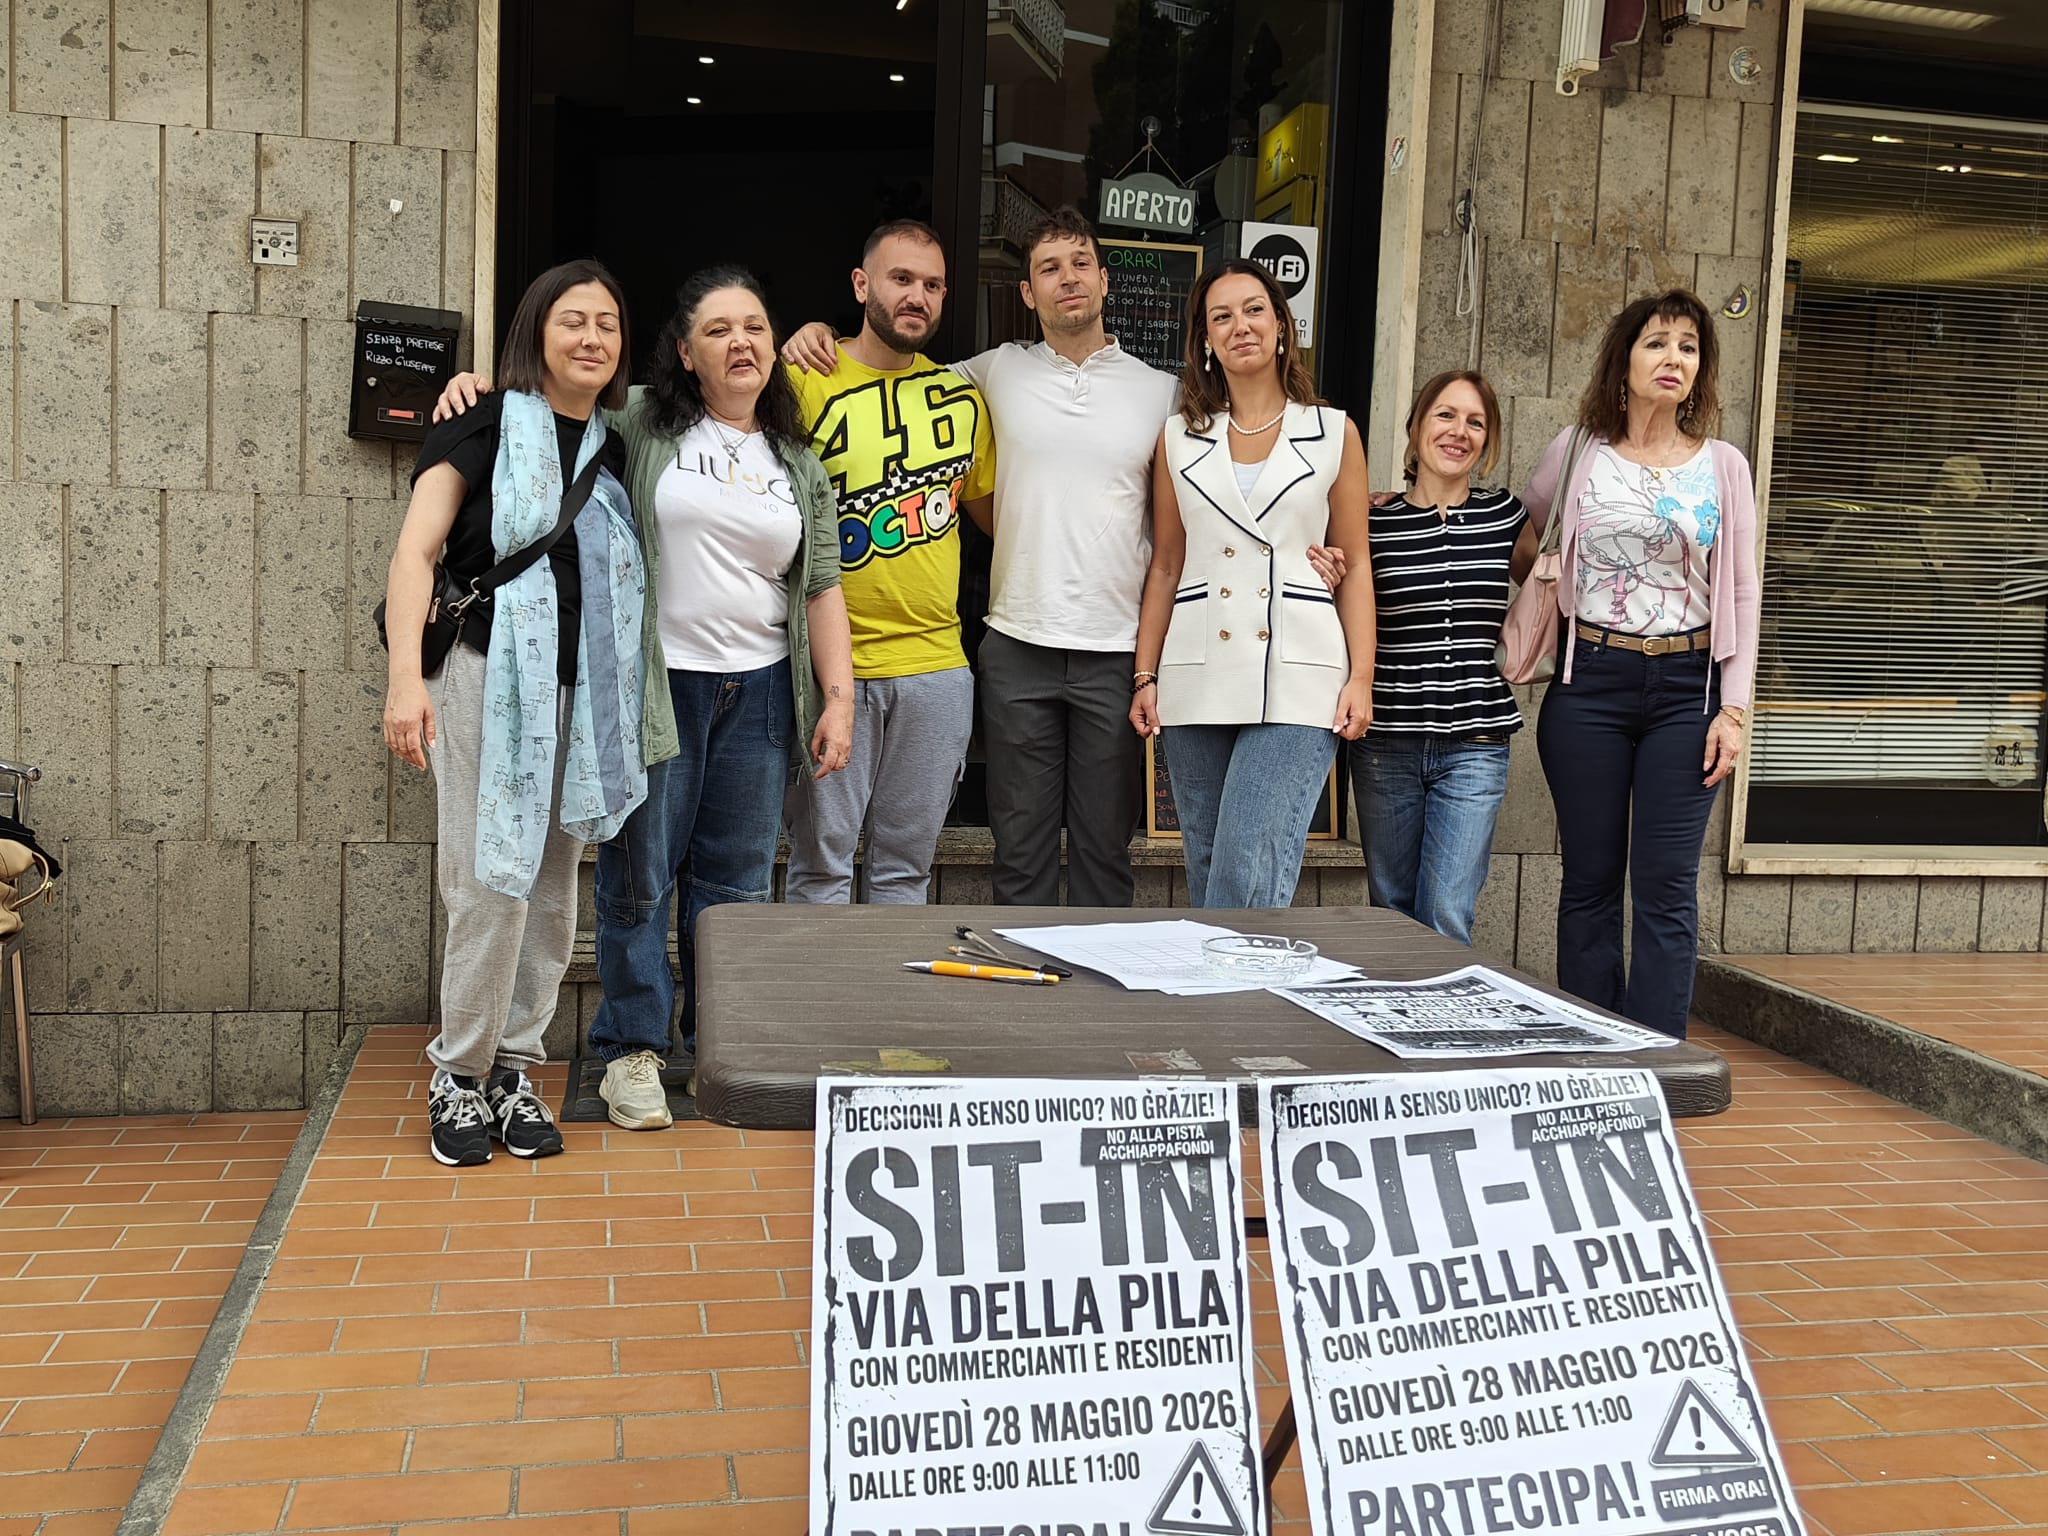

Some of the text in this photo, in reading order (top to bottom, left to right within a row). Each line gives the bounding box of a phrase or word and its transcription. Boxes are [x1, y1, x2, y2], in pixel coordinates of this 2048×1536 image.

[1105, 188, 1193, 227] APERTO
[1107, 250, 1163, 272] ORARI
[1160, 276, 1171, 286] AL
[1107, 293, 1134, 306] 8:00
[366, 333, 445, 352] SENZA PRETESE
[1105, 316, 1131, 326] NERDI
[1147, 320, 1180, 330] SABATO
[365, 350, 437, 374] RIZZO GIUSEPPE
[1120, 344, 1158, 354] OMENICA
[806, 368, 979, 495] 46
[1452, 998, 1514, 1008] UNICO
[845, 1090, 1215, 1133] DECISIONI A SENSO UNICO? NO GRAZIE!
[1287, 1073, 1641, 1129] DECISIONI A SENSO UNICO? NO GRAZIE!
[1536, 1102, 1634, 1127] NO ALLA PISTA
[1106, 1124, 1206, 1143] NO ALLA PISTA
[1531, 1115, 1647, 1143] ACCHIAPPAFONDI
[1099, 1140, 1215, 1161] ACCHIAPPAFONDI
[845, 1140, 1221, 1282] SIT-IN
[1291, 1128, 1673, 1267] SIT-IN
[1308, 1227, 1697, 1329] VIA DELLA PILA
[846, 1269, 1230, 1350] VIA DELLA PILA
[1322, 1282, 1709, 1363] CON COMMERCIANTI E RESIDENTI
[849, 1334, 1234, 1389] CON COMMERCIANTI E RESIDENTI
[1328, 1331, 1725, 1425] GIOVEDÌ 28 MAGGIO 2026
[848, 1389, 1237, 1458] GIOVEDÌ 28 MAGGIO 2026
[1338, 1395, 1634, 1465] DALLE ORE 9:00 ALLE 11:00
[849, 1451, 1140, 1502] DALLE ORE 9:00 ALLE 11:00
[1659, 1479, 1769, 1509] FIRMA ORA!
[1348, 1460, 1646, 1536] PARTECIPA!
